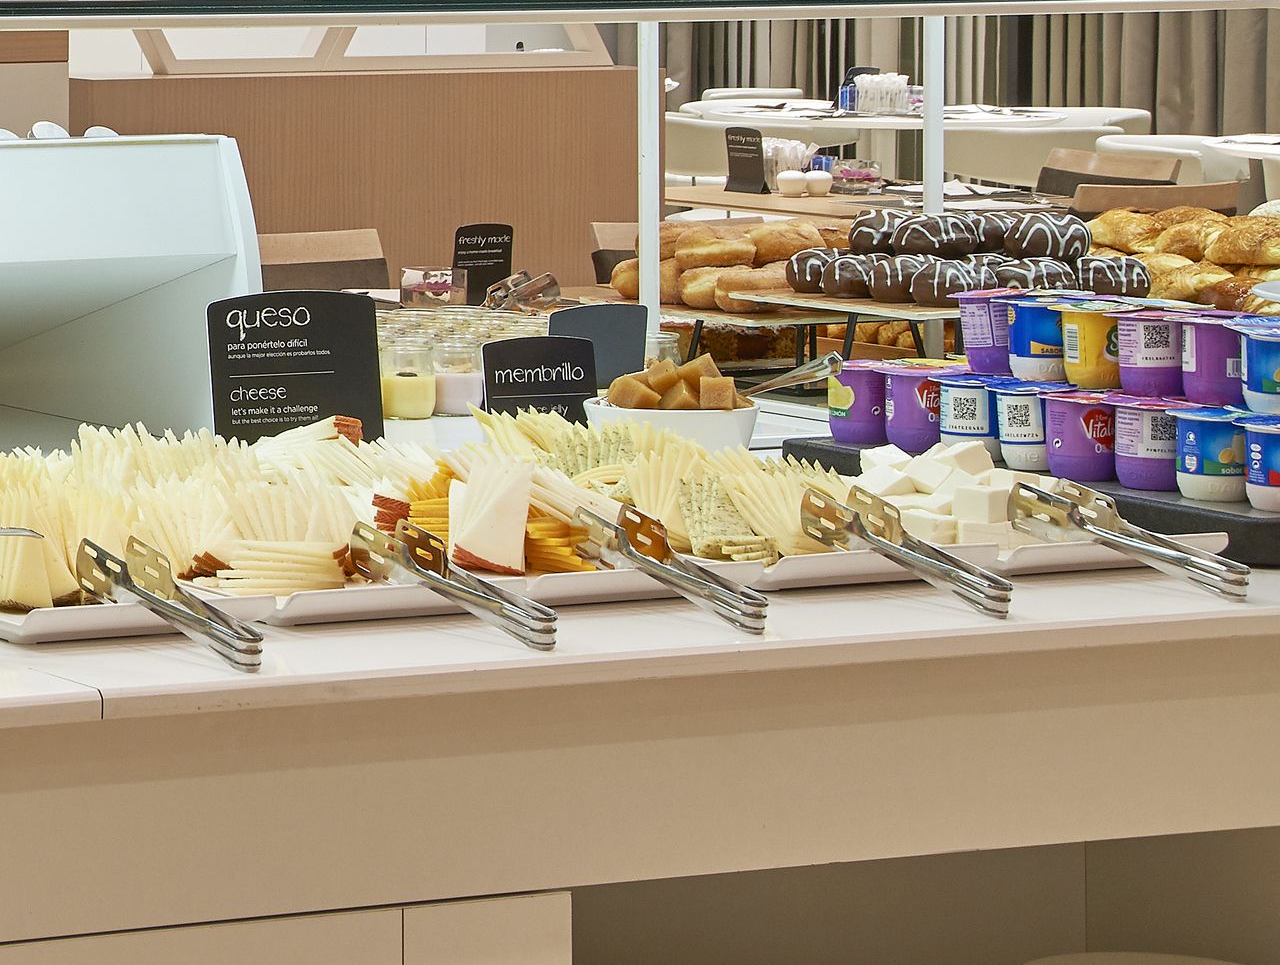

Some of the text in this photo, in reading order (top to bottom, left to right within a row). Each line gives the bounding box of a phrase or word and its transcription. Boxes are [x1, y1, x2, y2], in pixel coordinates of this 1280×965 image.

[458, 235, 510, 247] freshly made
[226, 307, 310, 341] queso
[227, 339, 308, 351] para ponértelo difícil
[494, 363, 584, 383] membrillo
[230, 386, 287, 402] cheese
[232, 408, 246, 416] let's
[248, 407, 268, 415] make
[270, 406, 275, 414] it
[283, 405, 318, 413] challenge
